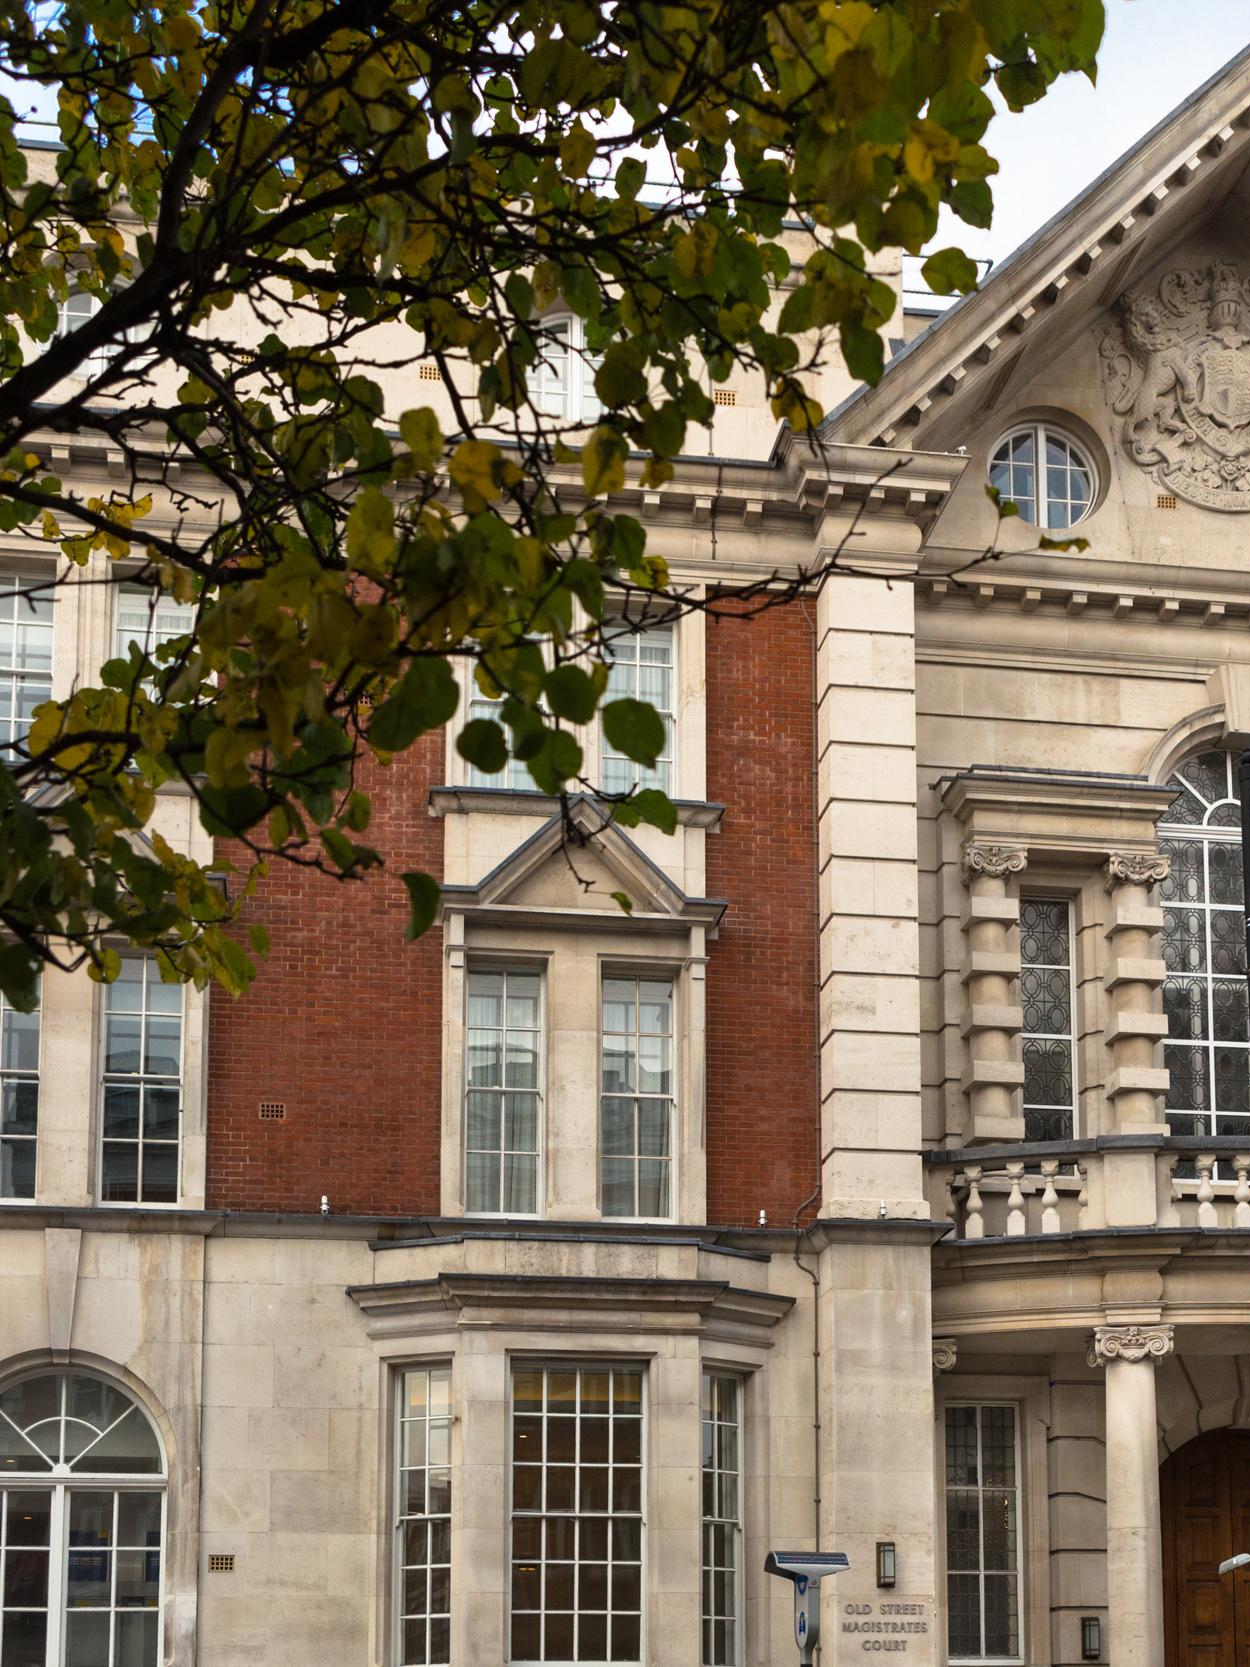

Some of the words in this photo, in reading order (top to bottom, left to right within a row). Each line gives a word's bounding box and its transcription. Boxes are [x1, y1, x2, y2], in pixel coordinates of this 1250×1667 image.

[845, 1604, 872, 1615] OLD
[880, 1604, 924, 1615] STREET
[842, 1622, 928, 1633] MAGISTRATES
[862, 1640, 908, 1651] COURT
